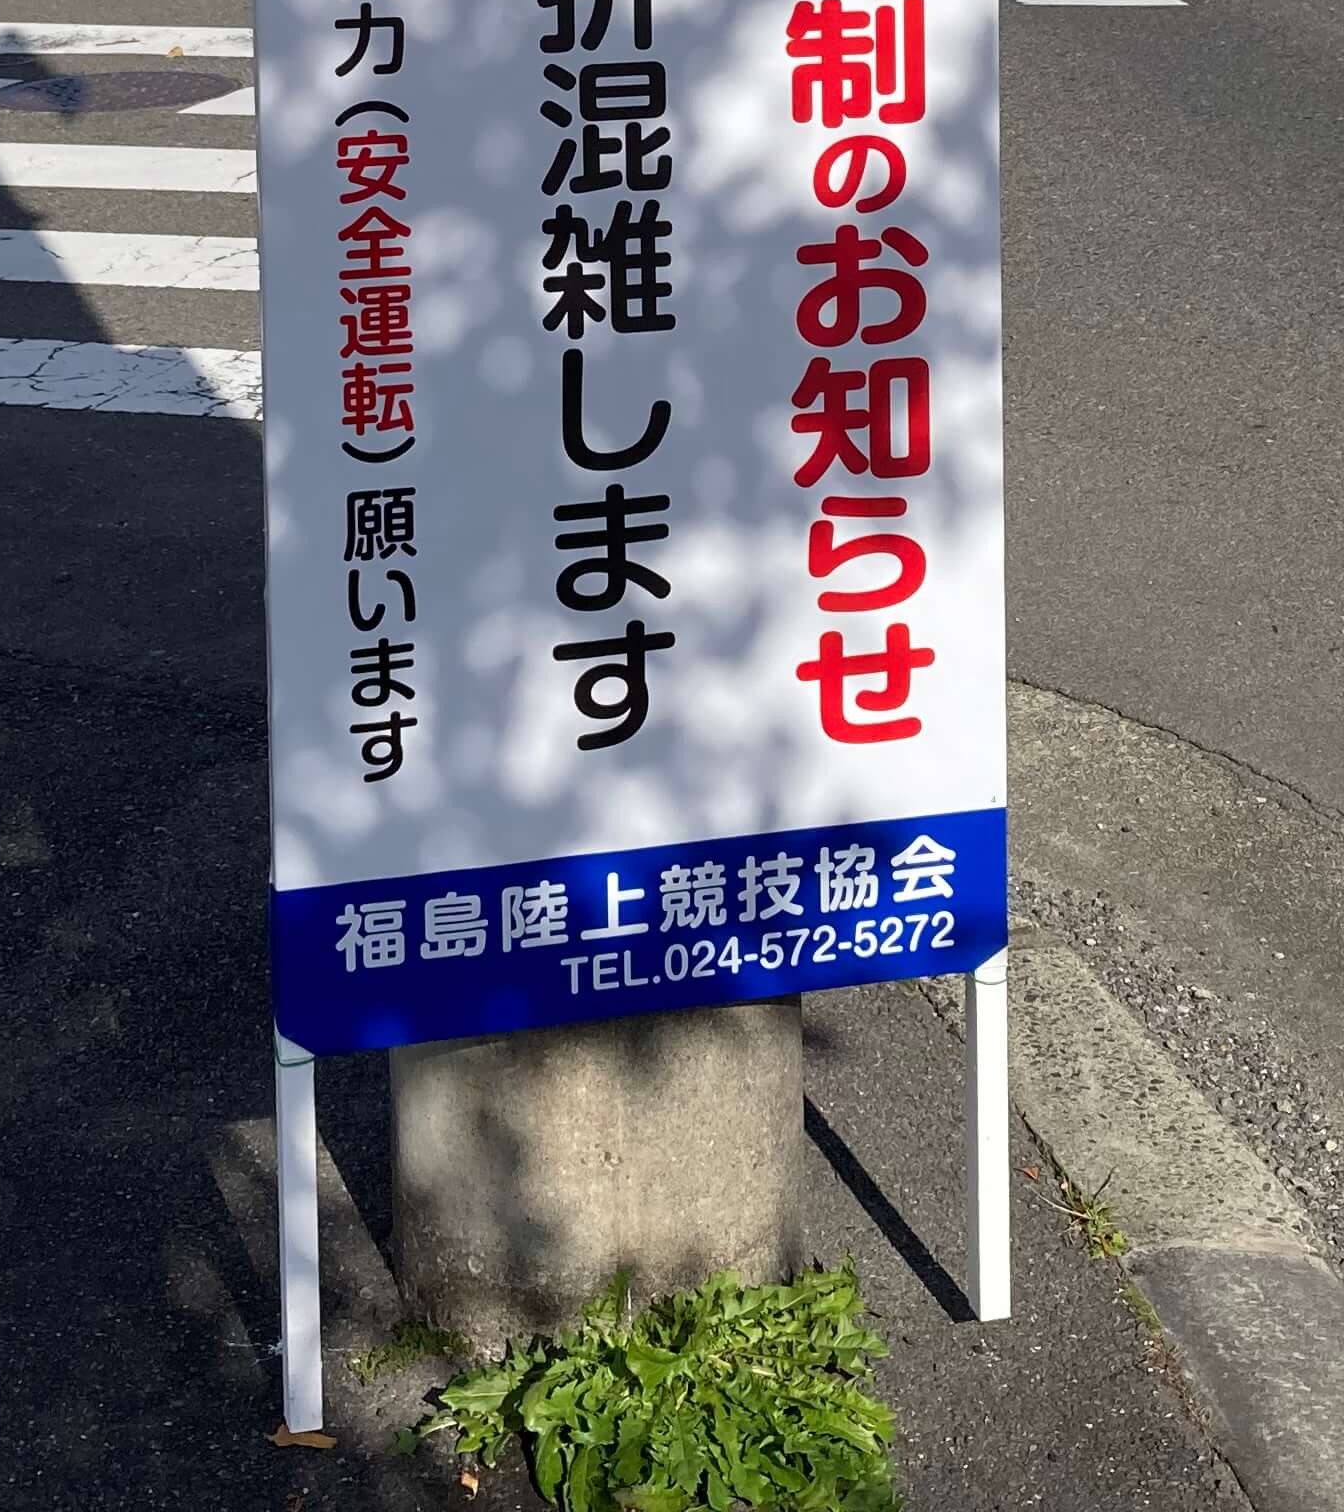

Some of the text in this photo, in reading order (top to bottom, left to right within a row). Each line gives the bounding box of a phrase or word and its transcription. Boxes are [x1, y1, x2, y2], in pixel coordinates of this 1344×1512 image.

[335, 833, 956, 975] 福島陸上競技協会
[561, 909, 955, 996] TEL.024-572-5272
